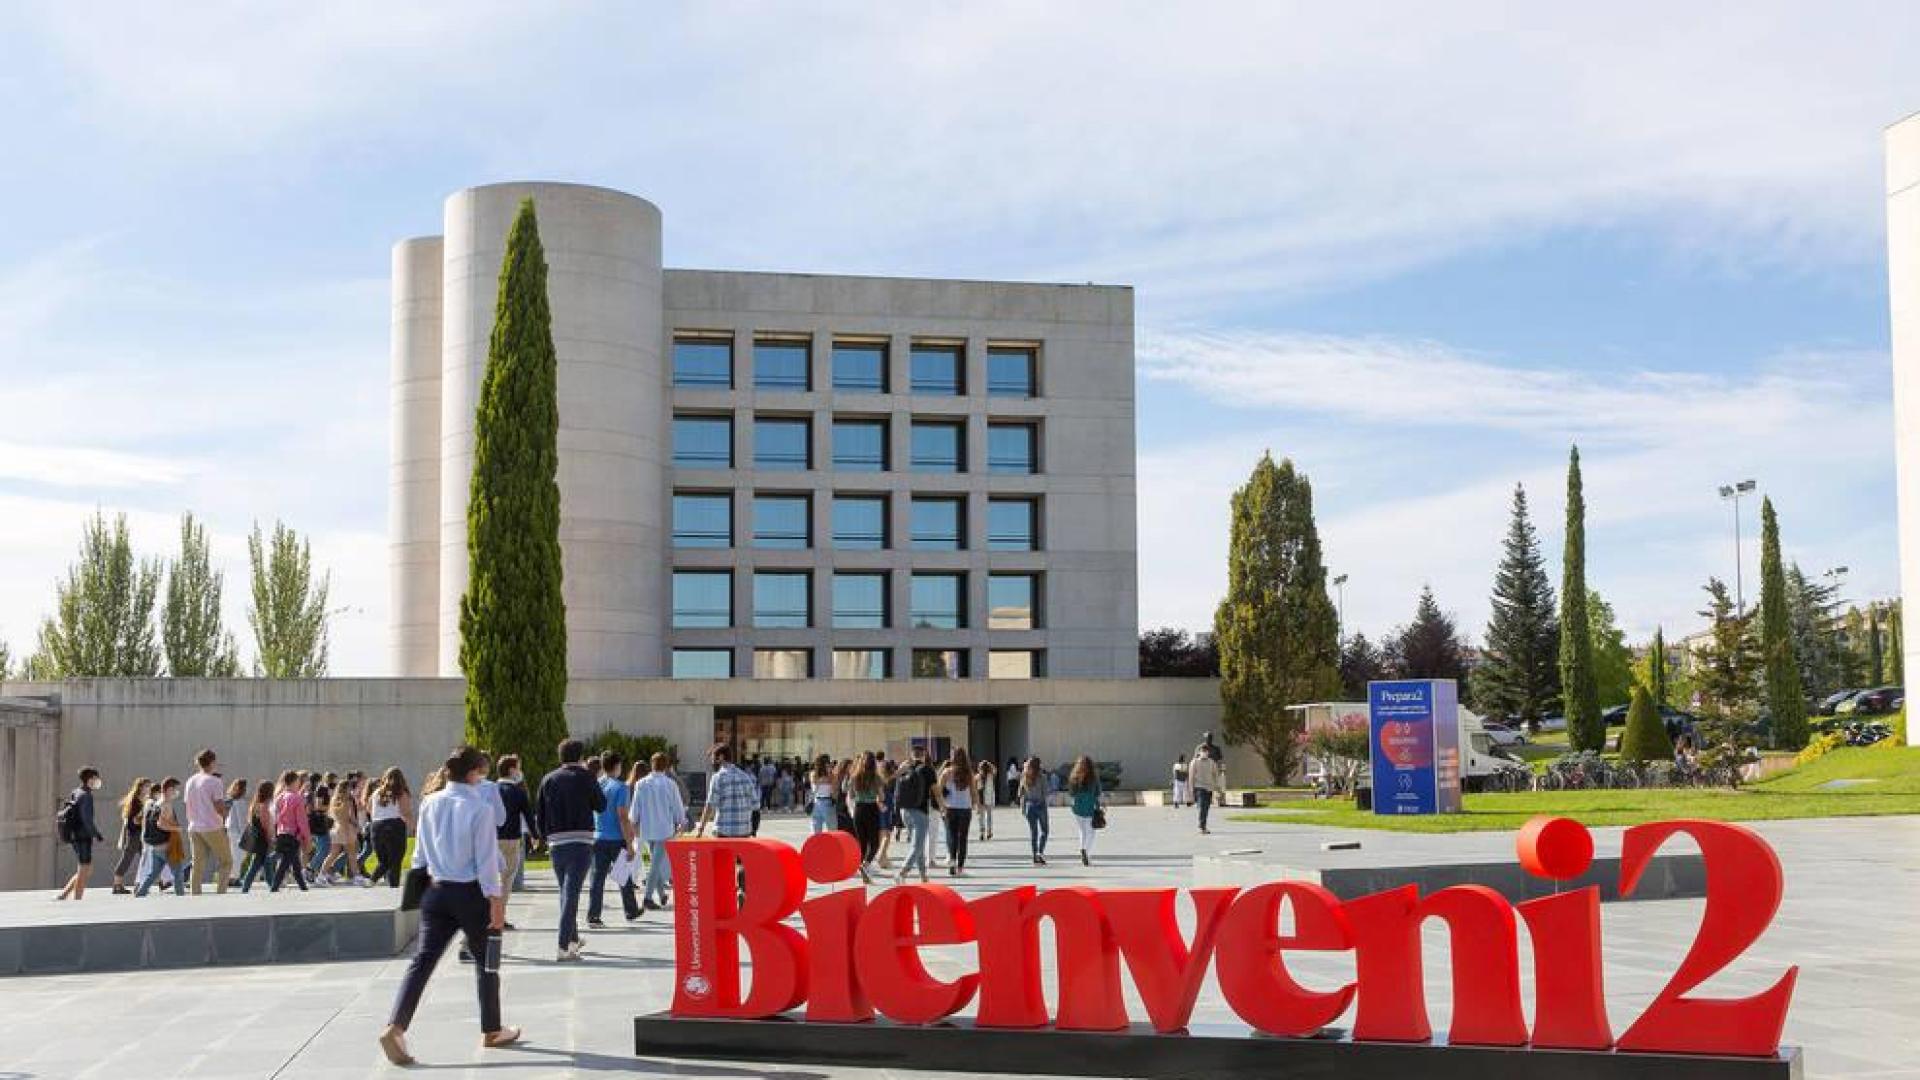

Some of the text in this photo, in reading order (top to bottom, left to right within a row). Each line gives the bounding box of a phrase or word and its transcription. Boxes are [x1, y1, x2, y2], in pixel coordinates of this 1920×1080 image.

[1382, 690, 1423, 702] Prepara2
[665, 816, 1798, 1057] Bienveni2
[688, 851, 701, 969] Universidad de Navarra
